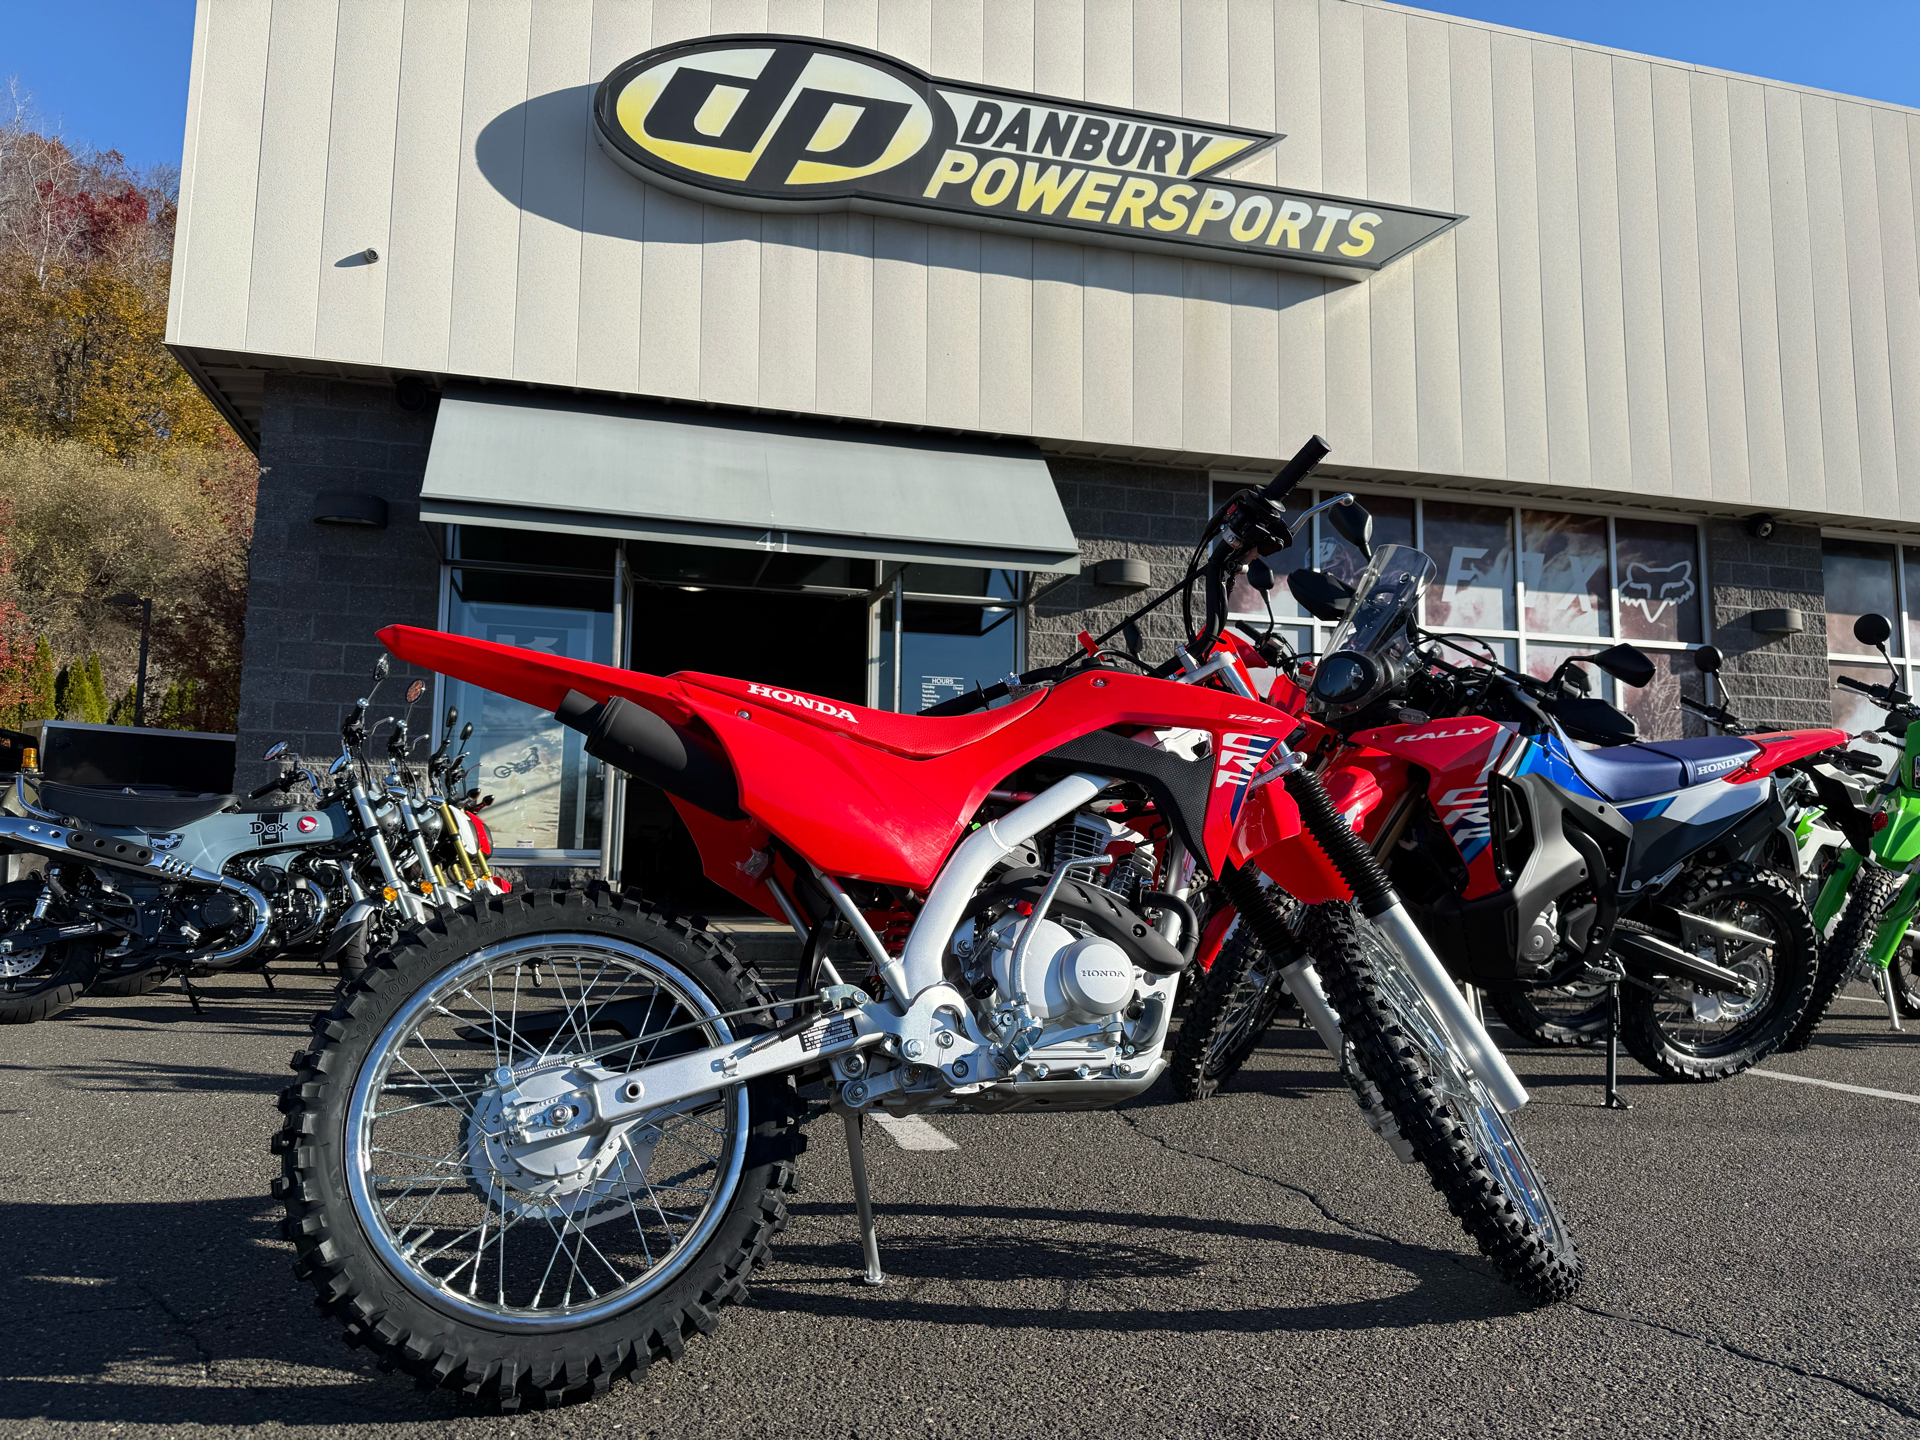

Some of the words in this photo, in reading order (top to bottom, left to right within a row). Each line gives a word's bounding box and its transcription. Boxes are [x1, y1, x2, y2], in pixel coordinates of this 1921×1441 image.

[959, 100, 1214, 177] DANBURY
[922, 149, 1383, 257] POWERSPORTS
[755, 530, 790, 553] 41
[746, 683, 859, 724] HONDA
[1227, 713, 1283, 724] 125F
[1394, 726, 1491, 743] RALLY
[1215, 732, 1272, 788] CRF
[1697, 757, 1745, 776] HONDA
[248, 821, 290, 835] Dax
[1081, 969, 1126, 978] HONDA
